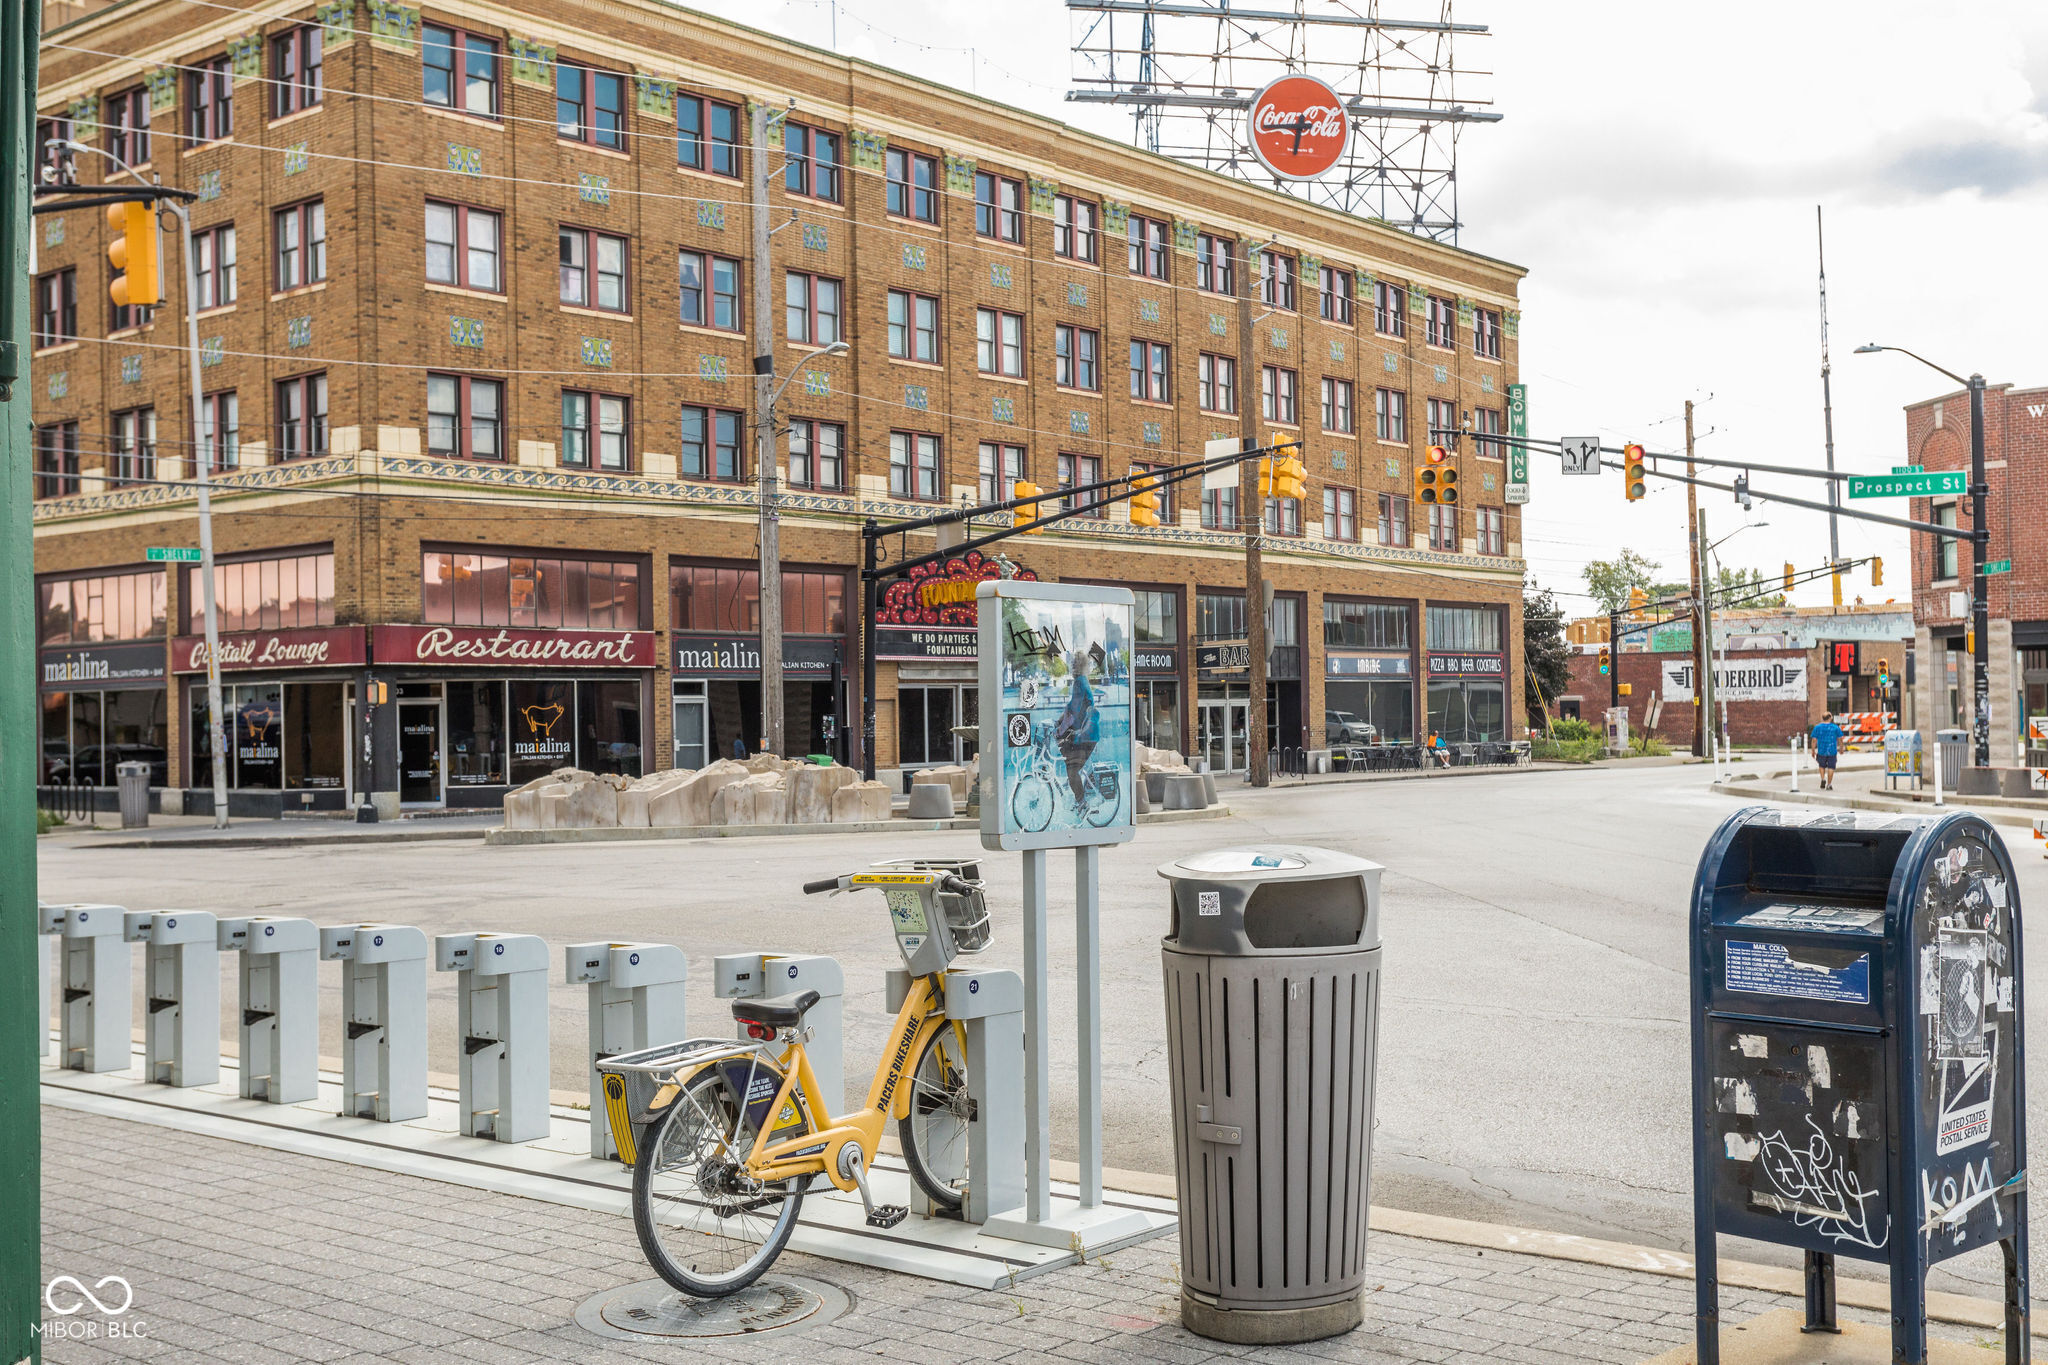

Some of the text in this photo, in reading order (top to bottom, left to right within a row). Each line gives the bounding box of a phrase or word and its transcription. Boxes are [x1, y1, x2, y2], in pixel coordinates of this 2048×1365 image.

[1512, 388, 1524, 480] BOWLING
[1854, 477, 1960, 494] Prospect St
[163, 549, 191, 560] SHELBY
[416, 628, 635, 663] Restaurant
[912, 634, 922, 643] WE
[926, 634, 935, 643] DO
[938, 635, 969, 644] PARTIES
[190, 637, 328, 669] Coktail Lounge
[1151, 655, 1171, 668] ROOM
[45, 652, 108, 682] maialina
[1358, 659, 1380, 672] IMBIBE
[1430, 658, 1501, 672] PIZZA BBQ BEER COCKTAILS
[240, 742, 279, 758] maialina
[515, 738, 570, 753] maialina
[877, 1014, 920, 1112] PACERS BIKESHARE
[1942, 1109, 1986, 1133] UNITED STATES
[1940, 1122, 1988, 1147] POSTAL SERVICE
